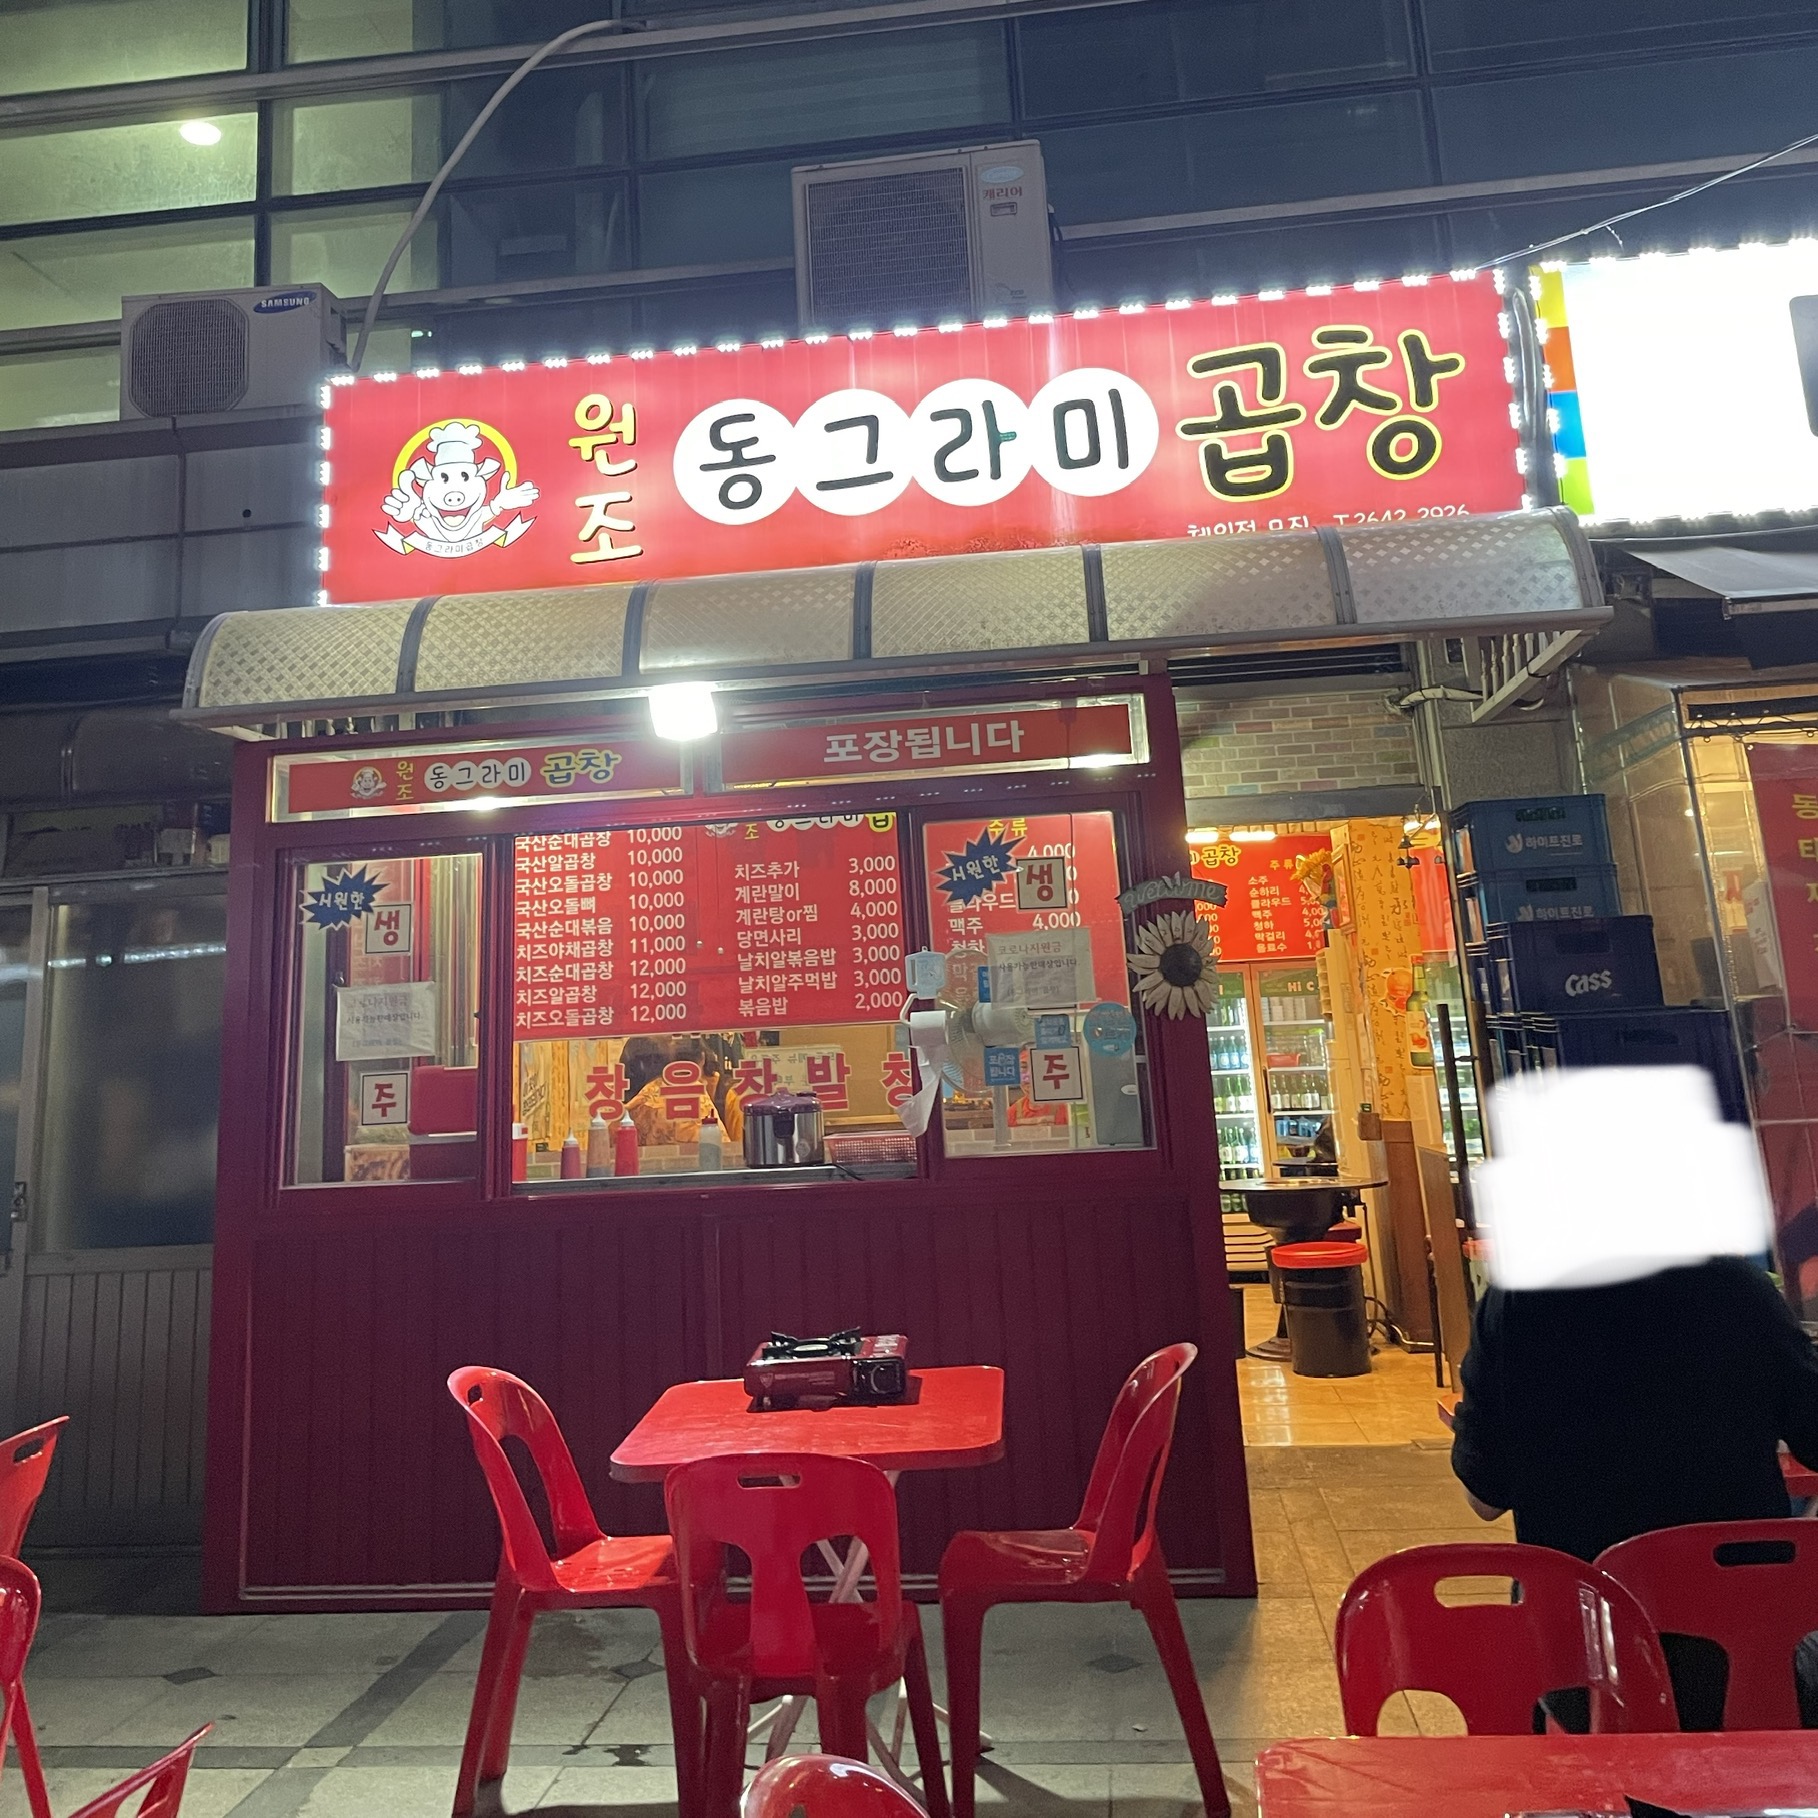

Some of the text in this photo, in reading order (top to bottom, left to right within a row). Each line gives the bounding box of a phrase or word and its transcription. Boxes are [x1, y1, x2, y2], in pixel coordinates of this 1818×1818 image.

[983, 186, 1023, 200] 캐리어
[261, 297, 310, 308] SAMSUNG
[700, 323, 1467, 511] 동그라미 곱창
[823, 719, 1025, 764] 포장됩니다
[429, 749, 622, 790] 동그라미 곱창
[627, 826, 682, 846] 10,000
[1525, 834, 1583, 850] 하이트진로
[515, 847, 683, 874] 국산알곱창 10,000
[735, 855, 896, 881] 치즈추가 3,000
[1202, 846, 1241, 868] 곱창
[515, 869, 684, 896] 국산오돌곱창 10,000
[735, 877, 897, 904] 계란말이 8,000
[1026, 863, 1053, 902] 생
[1248, 876, 1268, 885] 소주
[1249, 886, 1280, 898] 순하리
[318, 892, 365, 912] 시원한
[628, 892, 684, 912] 10,000
[850, 900, 898, 920] 4,000
[1535, 905, 1594, 920] 하이트진로
[374, 909, 400, 946] 생
[516, 914, 685, 940] 국산순대볶음 10,000
[736, 922, 899, 949] 당면사리 3,000
[948, 911, 1081, 936] 맥주 4,000
[516, 936, 686, 961] 치즈야채곱창 11,000
[737, 945, 900, 972] 날치알볶음밥 3,000
[516, 958, 686, 984] 치즈순대곱창 12,000
[738, 968, 901, 994] 날치알주먹밥 3,000
[1564, 968, 1613, 998] Cass
[516, 981, 686, 1007] 치즈알곱창 12,000
[738, 991, 903, 1018] 볶음밥 2,000
[516, 1003, 687, 1029] 치즈오돌곱창 12,000
[1043, 1054, 1070, 1090] 주
[372, 1083, 397, 1118] 주
